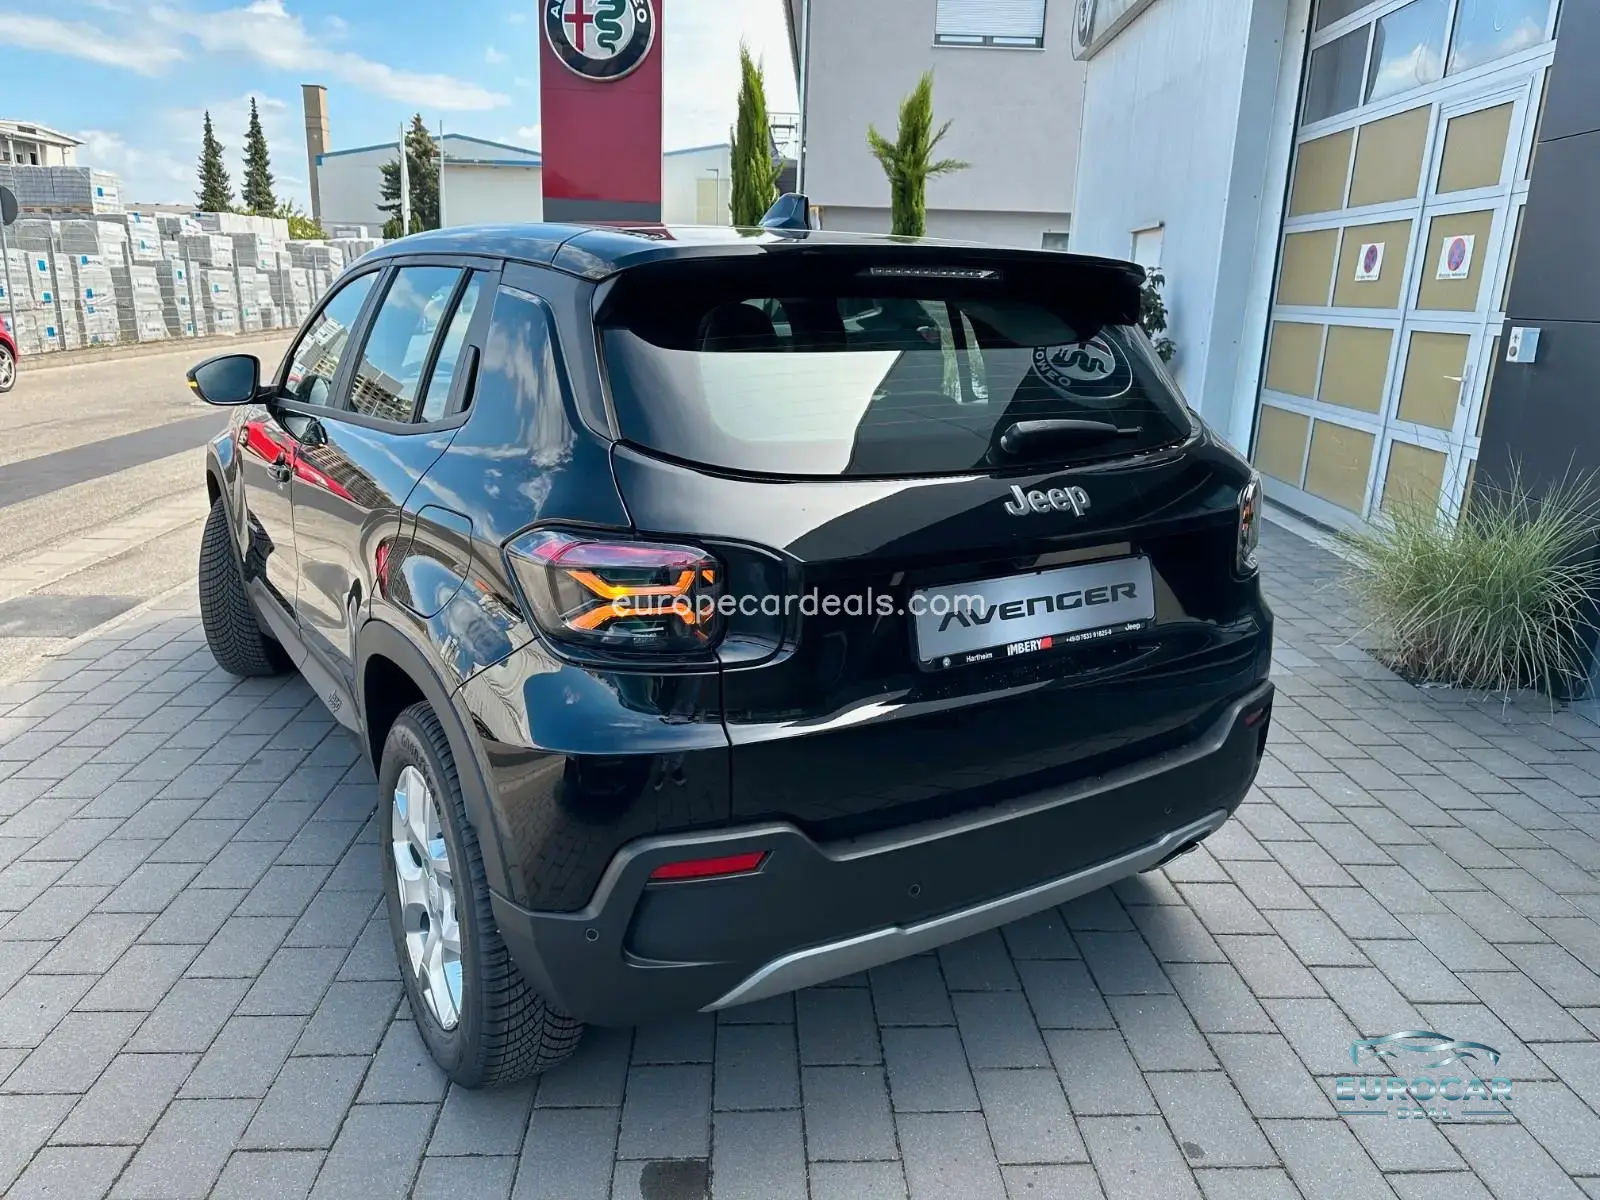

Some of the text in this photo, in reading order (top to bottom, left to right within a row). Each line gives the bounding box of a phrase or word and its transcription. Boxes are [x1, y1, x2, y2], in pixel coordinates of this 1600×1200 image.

[1004, 484, 1091, 518] Jeep
[938, 582, 1138, 632] AVENGER
[1007, 639, 1044, 656] IMBERY
[1124, 622, 1141, 631] Jeep
